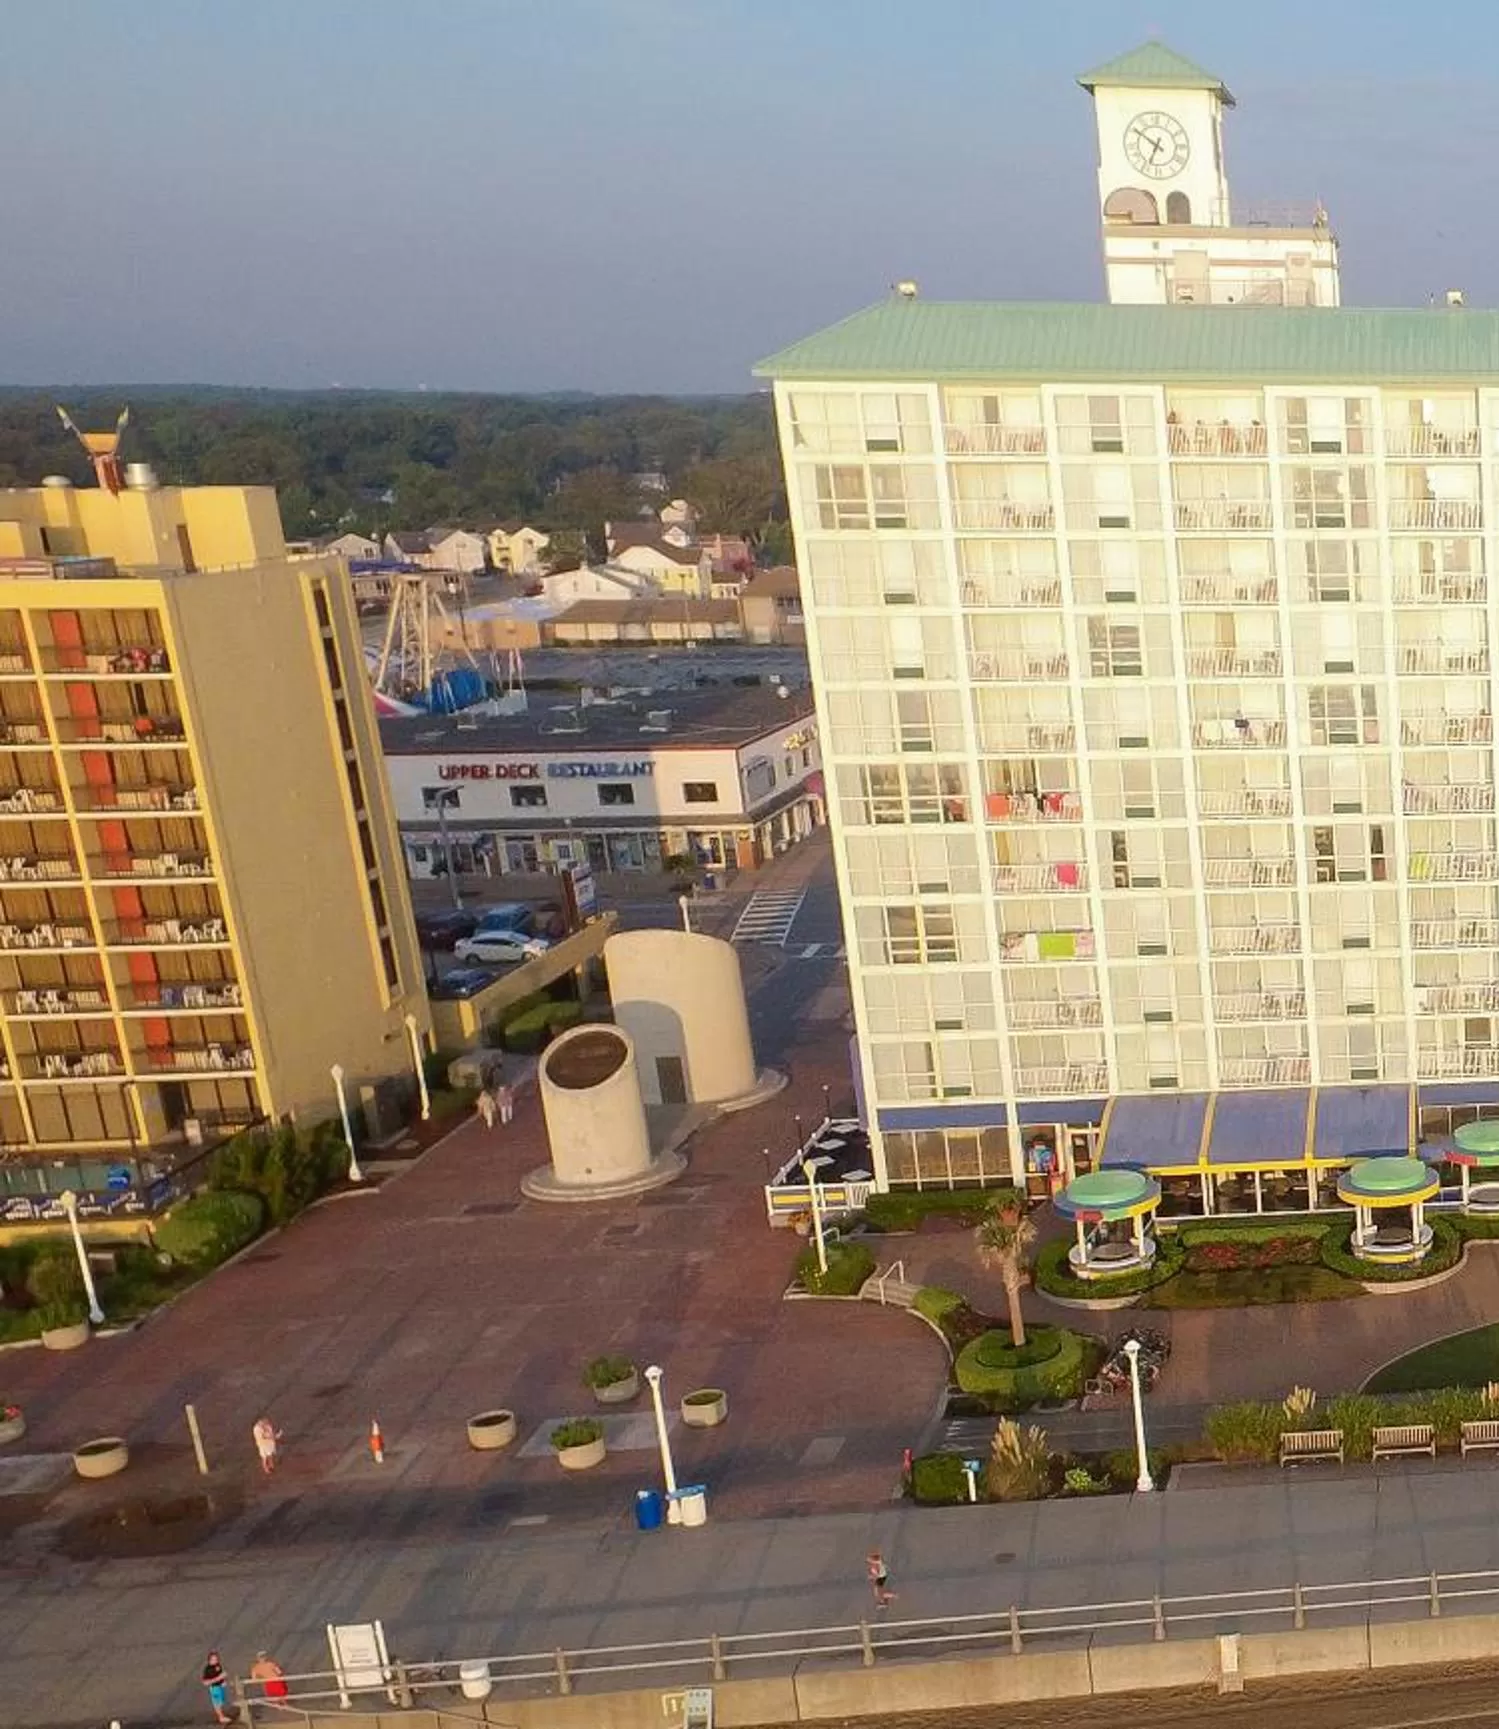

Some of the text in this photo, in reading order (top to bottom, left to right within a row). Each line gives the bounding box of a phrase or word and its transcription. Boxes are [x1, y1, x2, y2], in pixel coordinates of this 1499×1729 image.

[438, 761, 657, 780] UPPER DECK RESTAURANT
